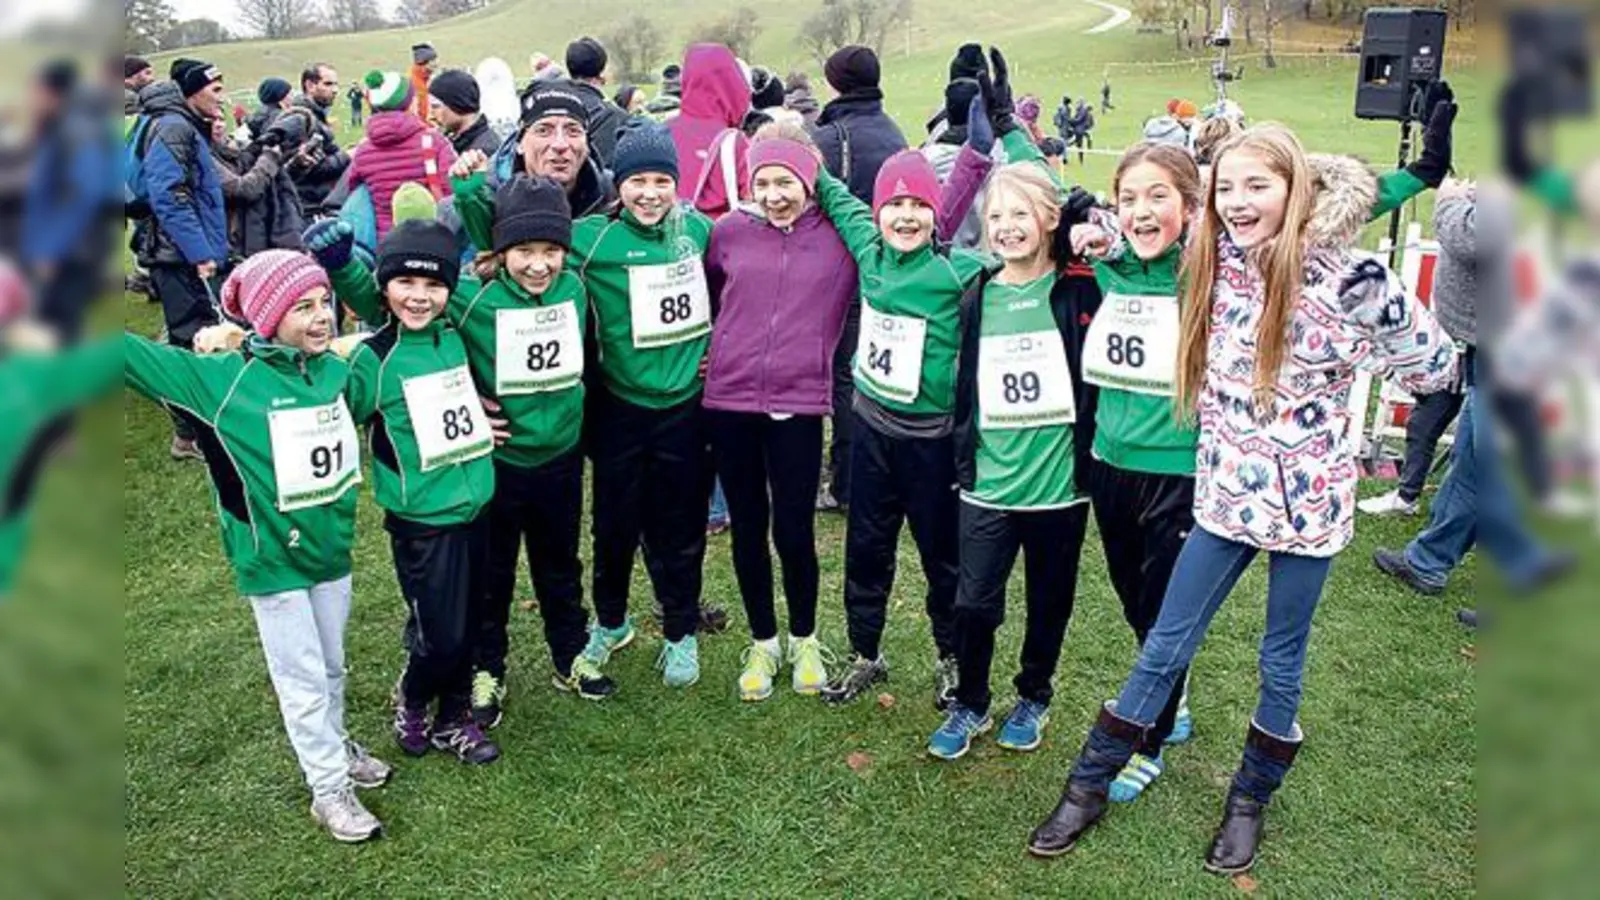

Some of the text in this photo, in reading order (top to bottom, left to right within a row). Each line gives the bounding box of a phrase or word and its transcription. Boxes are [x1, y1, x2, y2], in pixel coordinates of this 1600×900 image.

[660, 293, 691, 324] 88
[527, 340, 560, 372] 82
[868, 341, 892, 375] 84
[1107, 332, 1145, 368] 86
[1003, 371, 1040, 403] 89
[443, 405, 474, 440] 83
[310, 439, 343, 479] 91
[289, 529, 300, 547] 2
